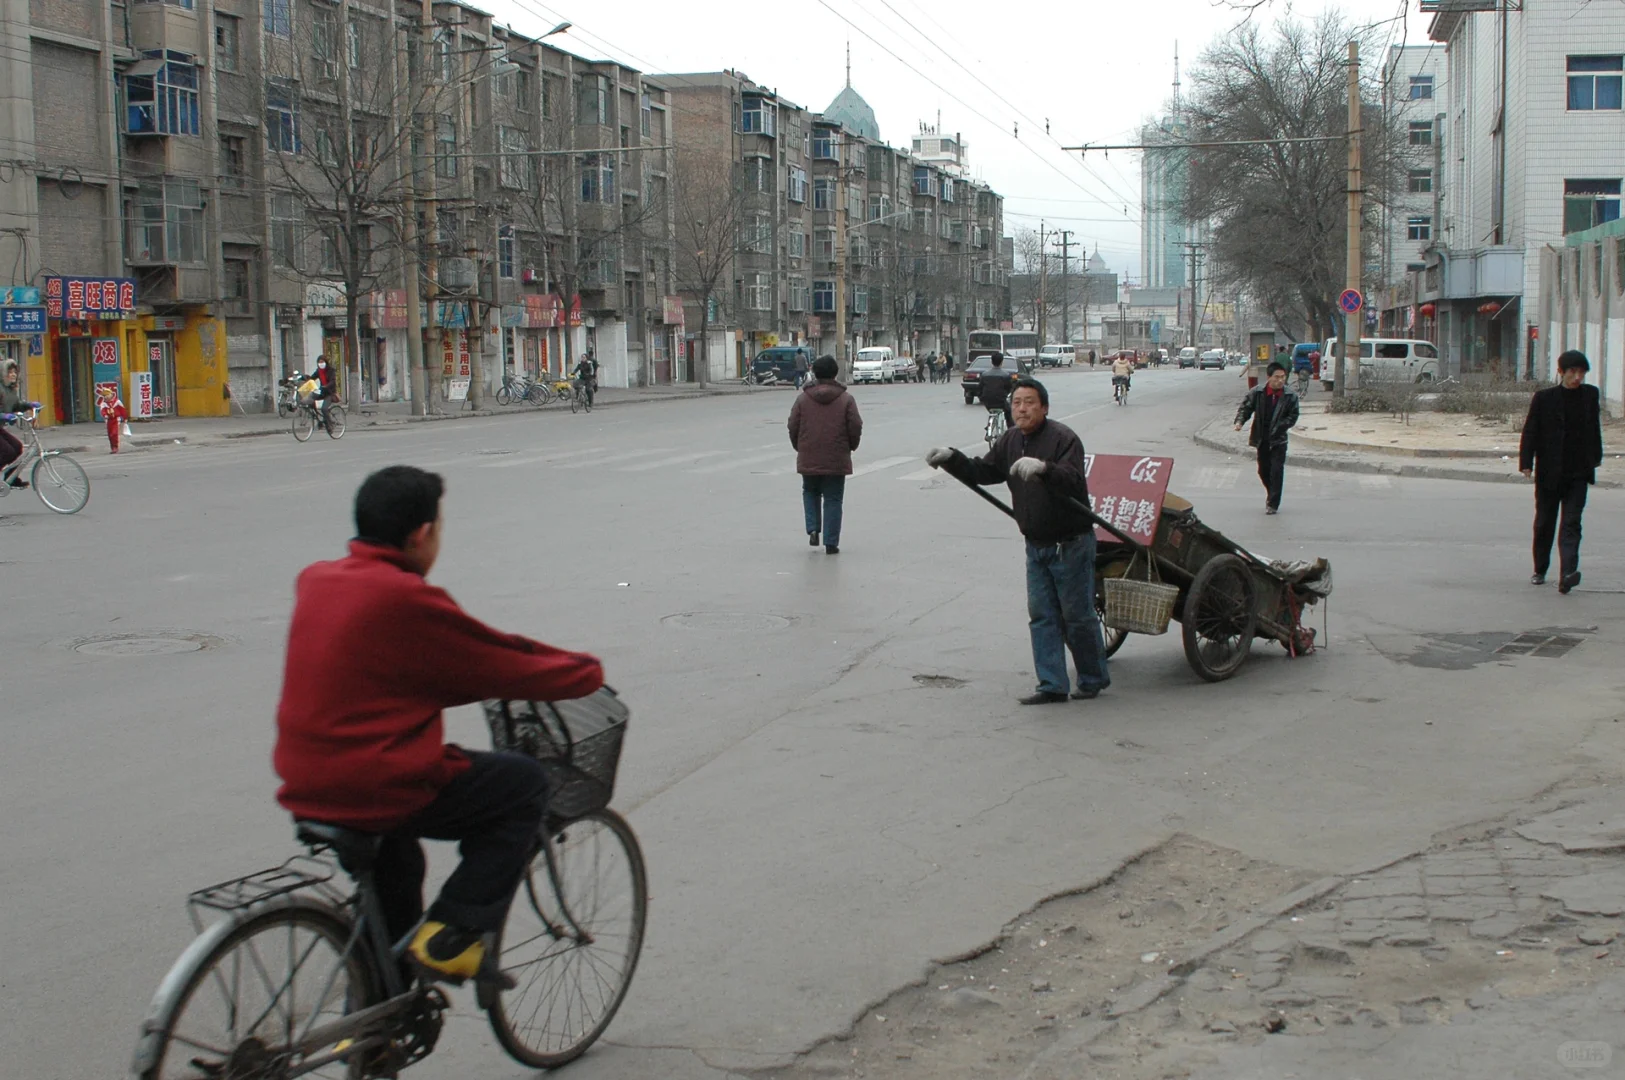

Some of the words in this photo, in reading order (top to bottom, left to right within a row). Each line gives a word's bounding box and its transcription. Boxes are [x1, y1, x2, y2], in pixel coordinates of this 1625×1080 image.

[47, 278, 63, 317] 烟酒
[68, 280, 134, 310] 喜旺商店
[5, 311, 39, 323] 五一东街
[140, 383, 151, 415] 香烟
